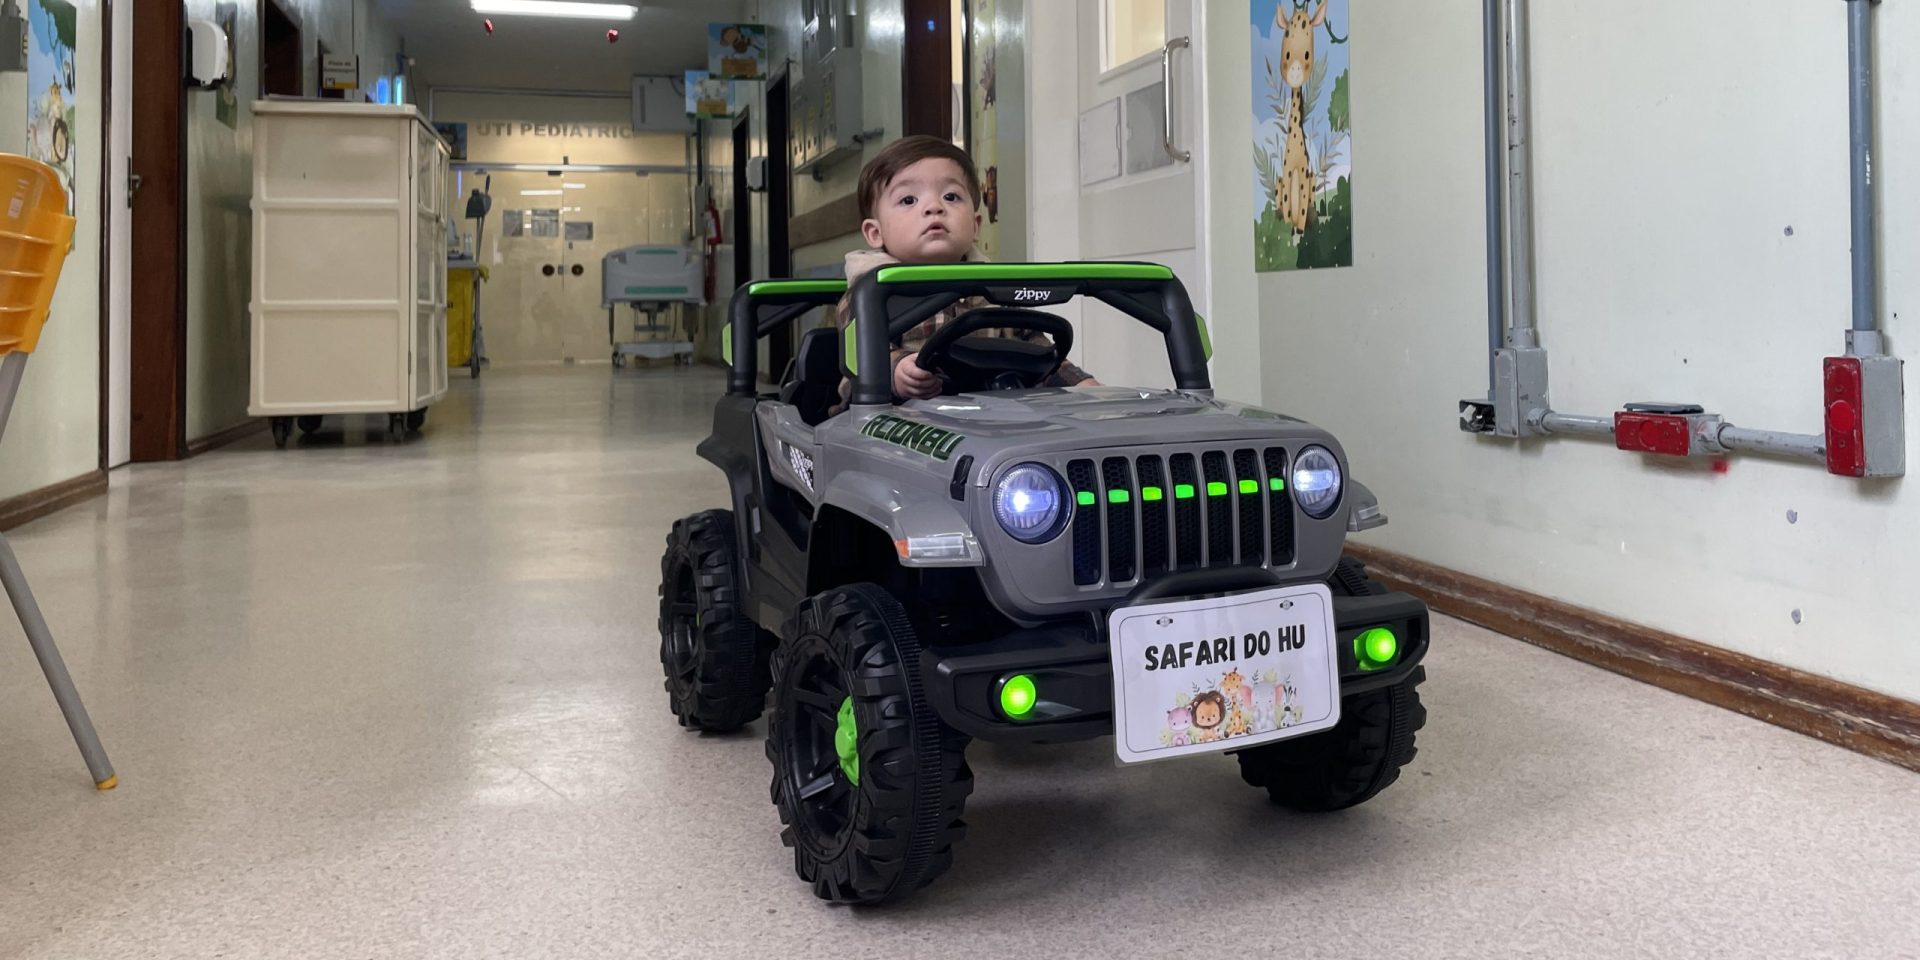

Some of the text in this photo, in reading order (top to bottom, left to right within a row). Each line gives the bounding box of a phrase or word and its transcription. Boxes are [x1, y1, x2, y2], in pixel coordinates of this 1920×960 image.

[476, 122, 636, 139] UTI PEDIATRIC
[1144, 624, 1306, 671] SAFARI DO HU
